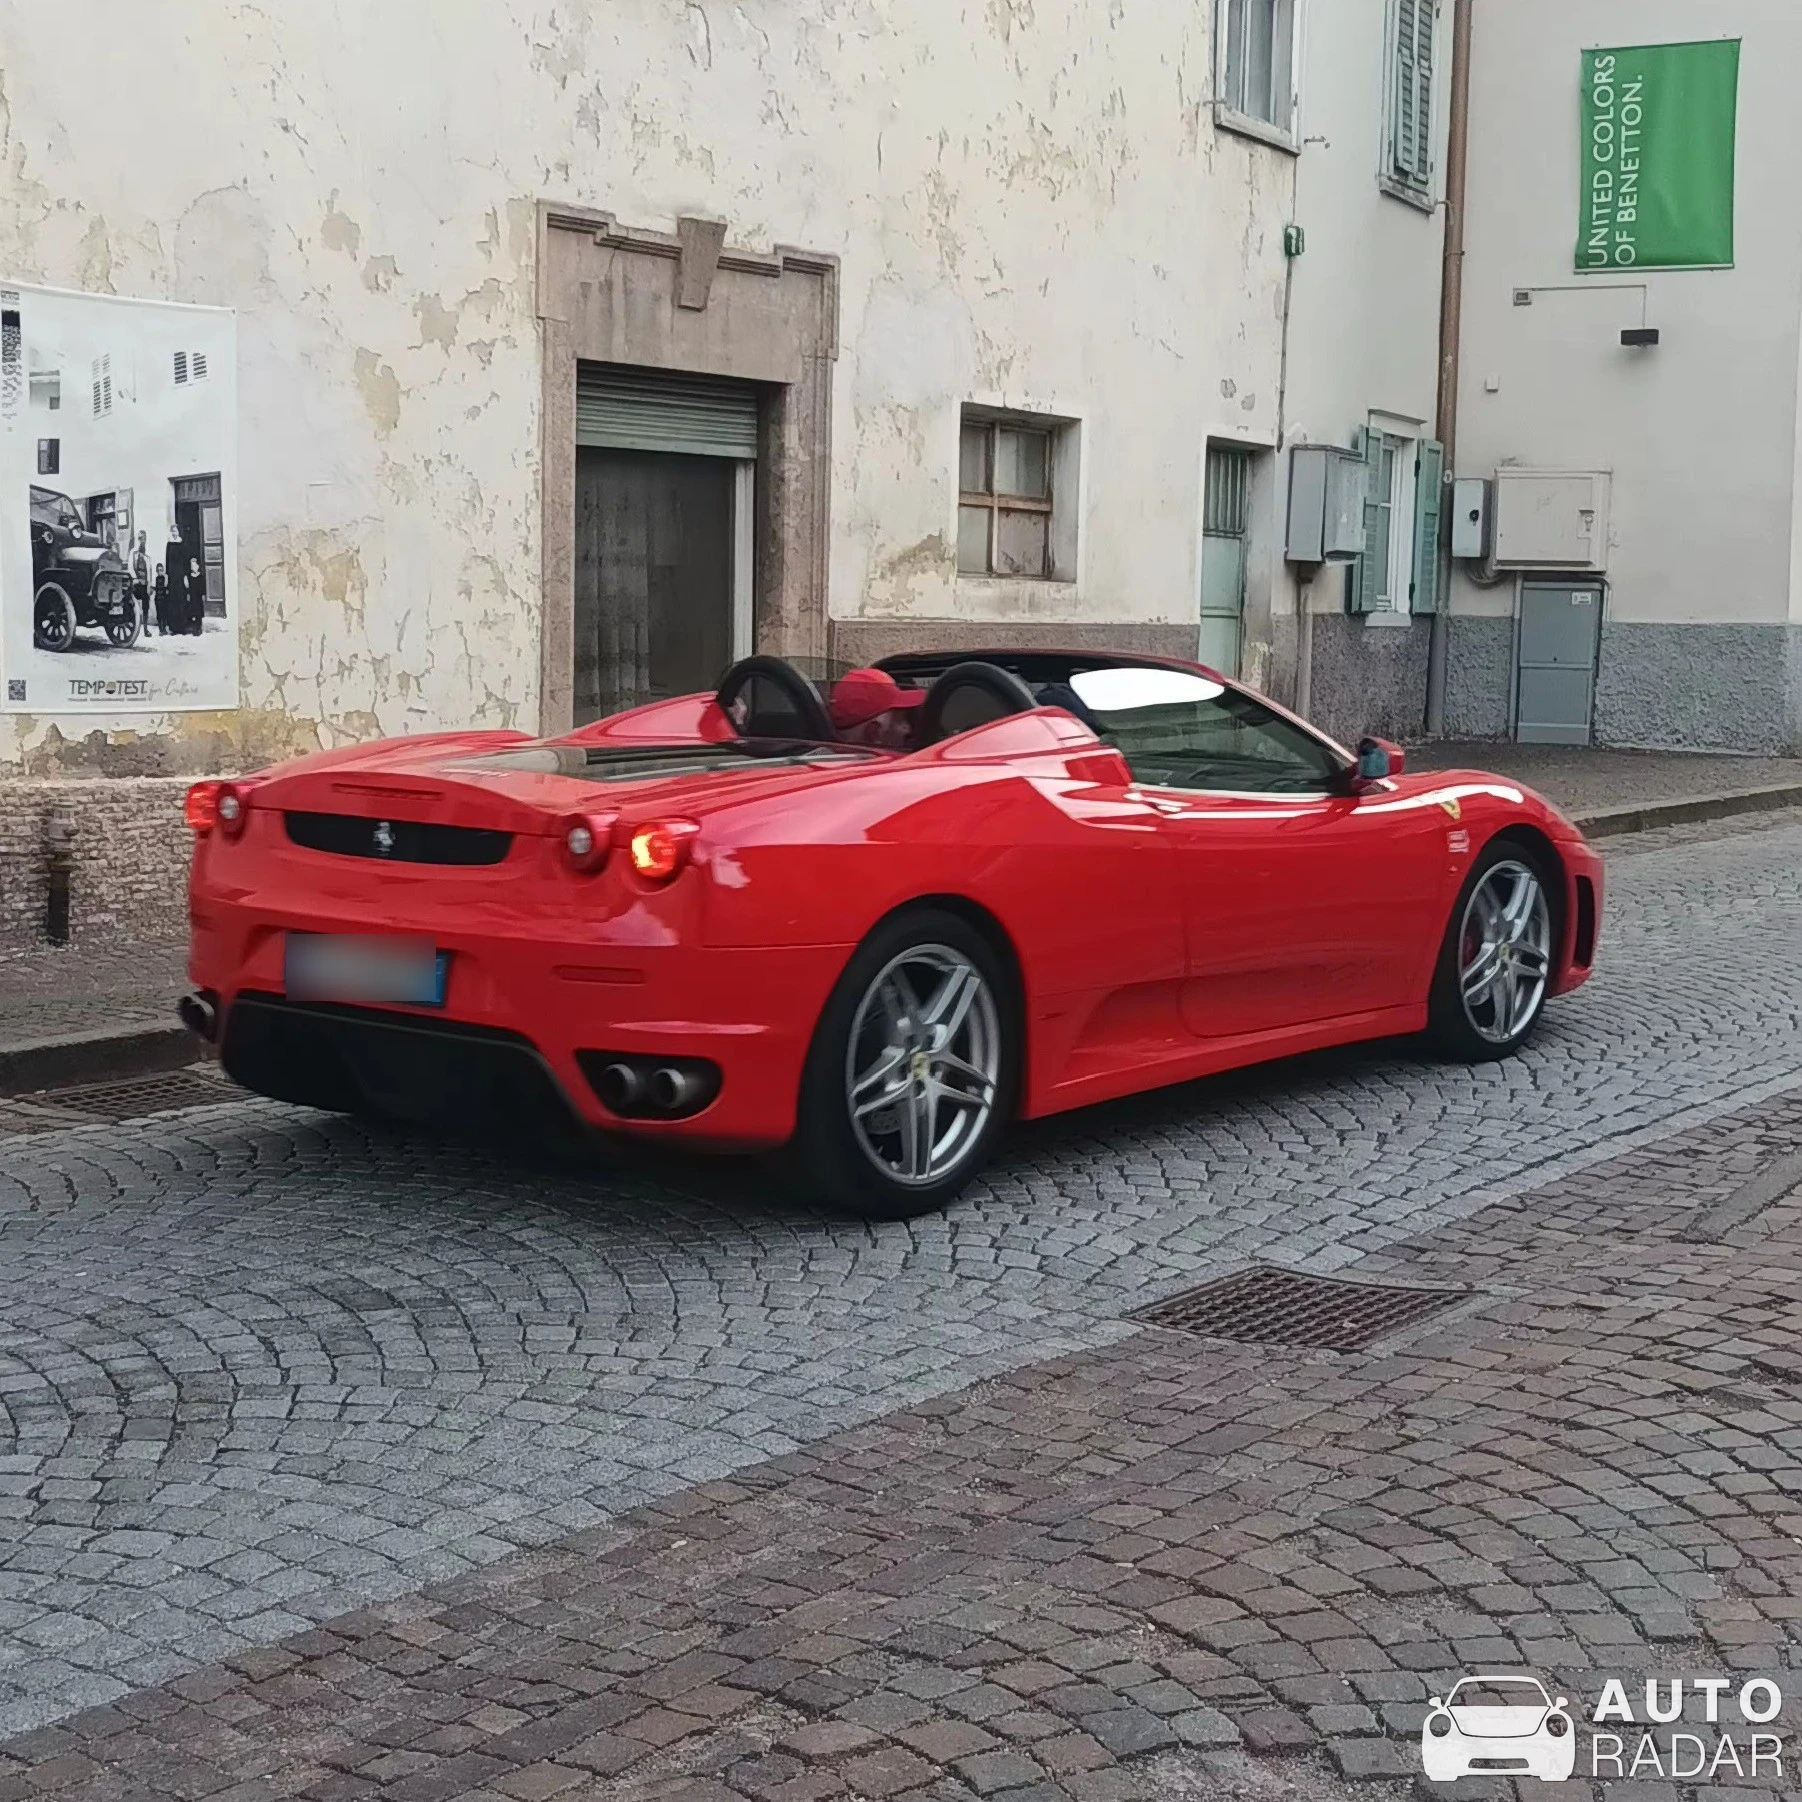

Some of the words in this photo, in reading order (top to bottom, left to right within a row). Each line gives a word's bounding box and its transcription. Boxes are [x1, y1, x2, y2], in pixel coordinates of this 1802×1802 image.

[1593, 55, 1616, 162] COLORS
[1616, 74, 1643, 222] BENETTON.
[1588, 169, 1613, 266] UNITED
[1614, 230, 1636, 265] OF
